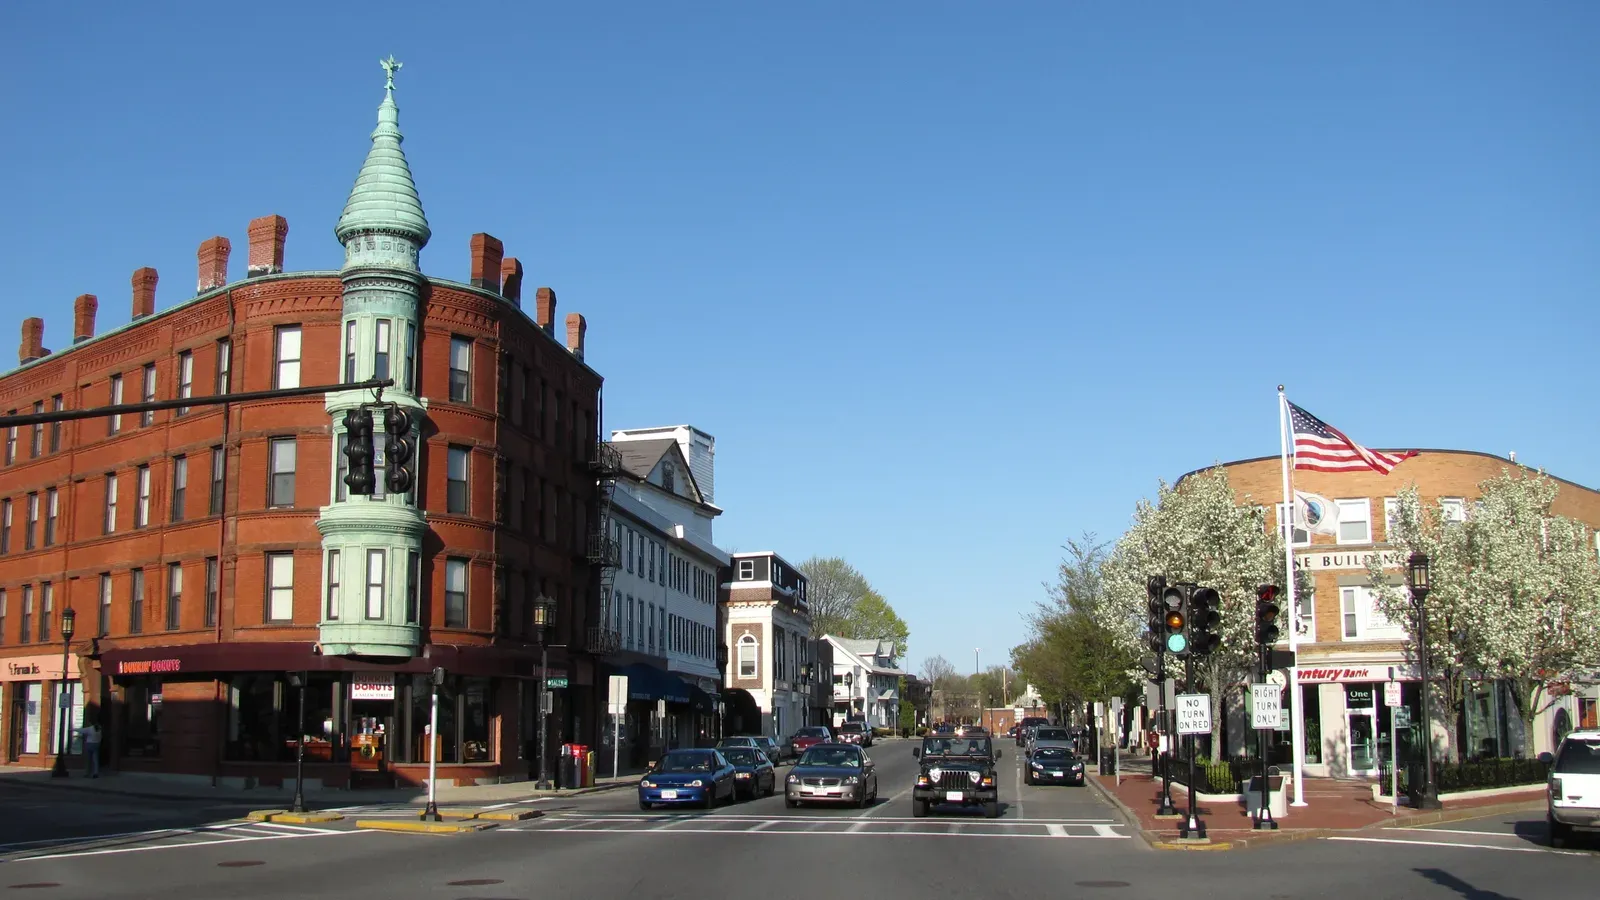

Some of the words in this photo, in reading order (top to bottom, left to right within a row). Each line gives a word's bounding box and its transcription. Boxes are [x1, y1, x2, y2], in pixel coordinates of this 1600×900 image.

[1323, 554, 1405, 567] BUILDNG
[151, 659, 180, 672] DONUTS
[1297, 668, 1342, 681] entury
[1343, 669, 1369, 678] Bank
[354, 683, 393, 691] DONUTS
[1254, 689, 1277, 698] RIGHT
[1256, 702, 1278, 710] TURN
[1182, 710, 1205, 718] TURN
[1256, 715, 1277, 724] ONLY
[1180, 721, 1190, 729] ON
[1192, 720, 1208, 729] RED
